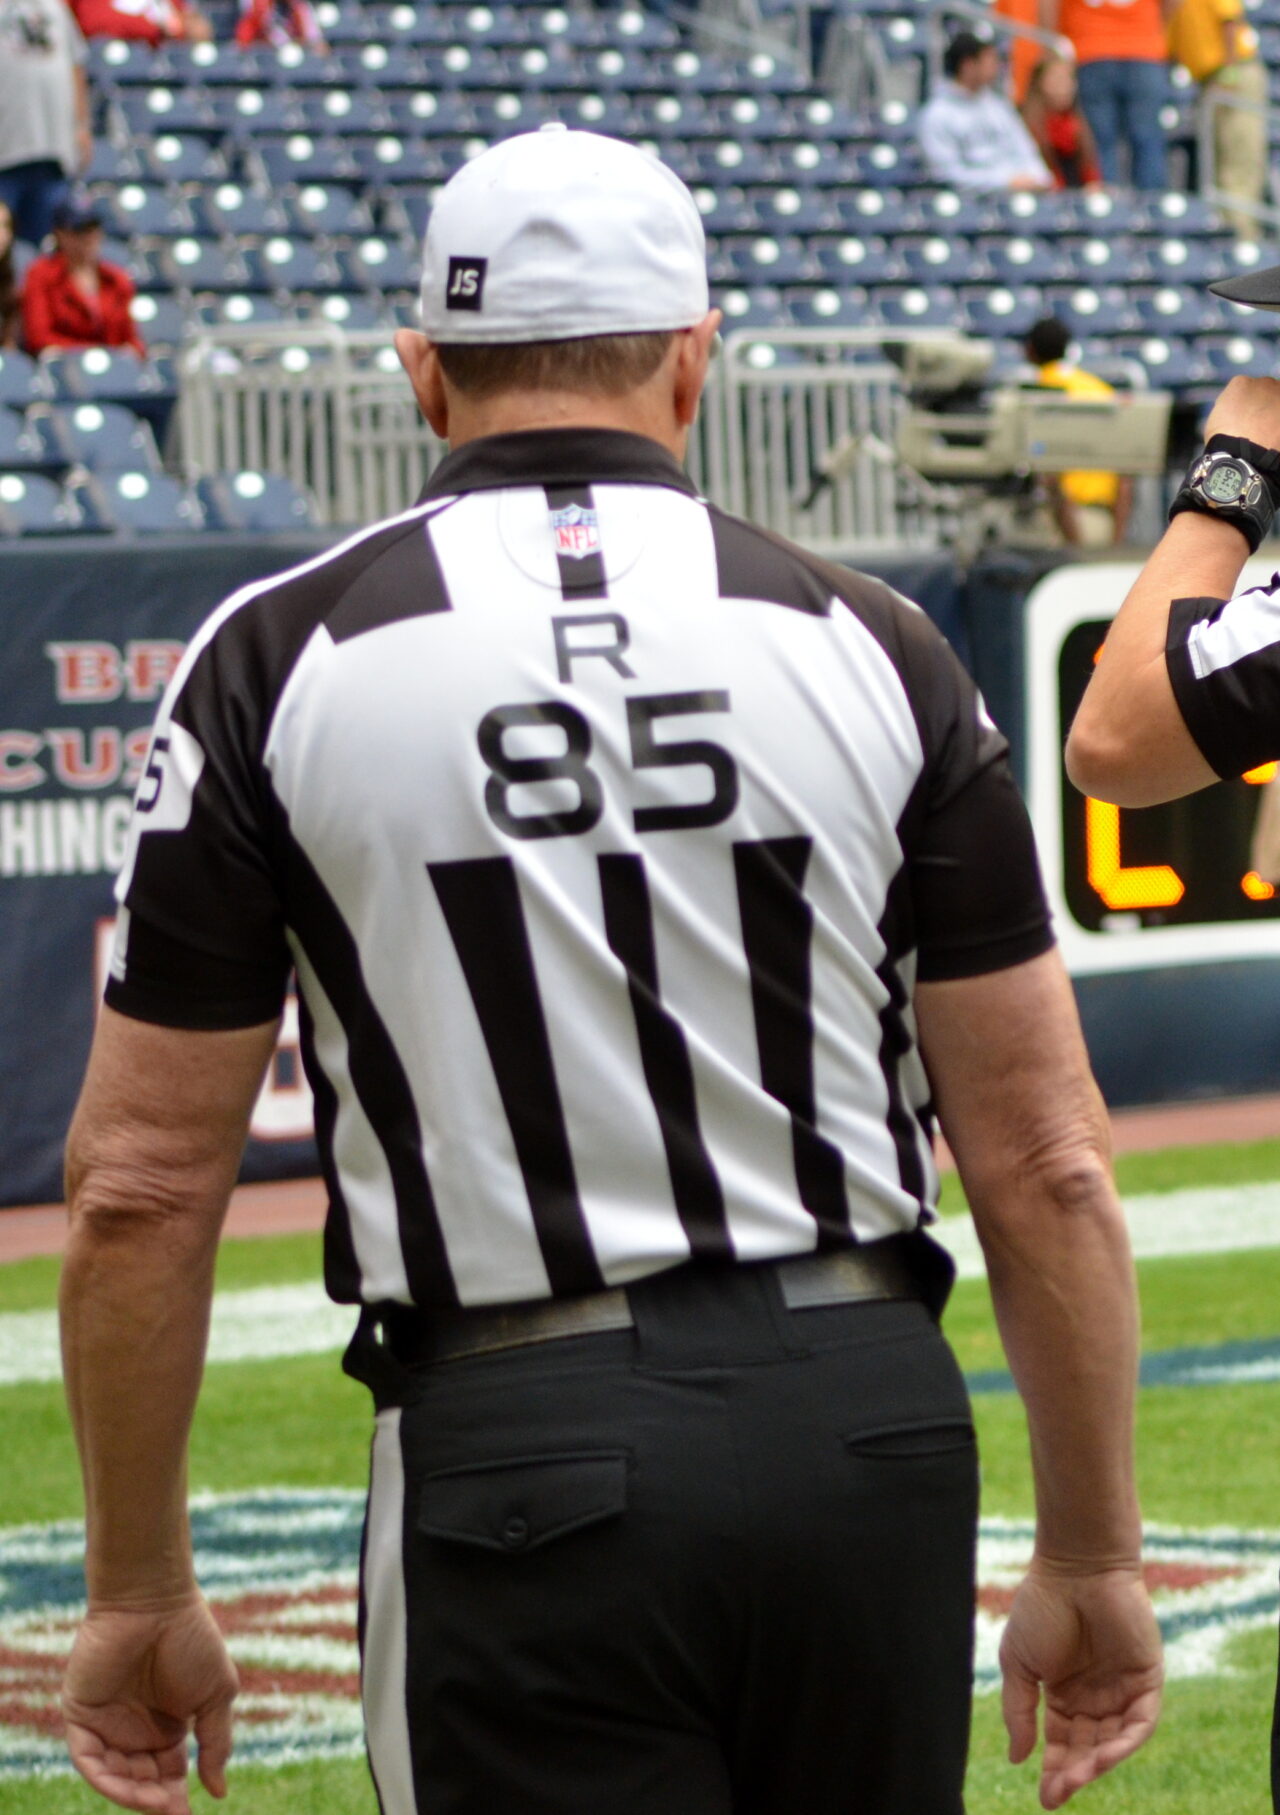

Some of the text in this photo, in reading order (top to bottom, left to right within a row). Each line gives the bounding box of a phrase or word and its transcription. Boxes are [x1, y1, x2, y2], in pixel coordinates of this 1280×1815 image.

[450, 268, 479, 296] JS
[557, 525, 598, 550] NFL
[551, 611, 638, 684] R
[477, 689, 740, 842] 85
